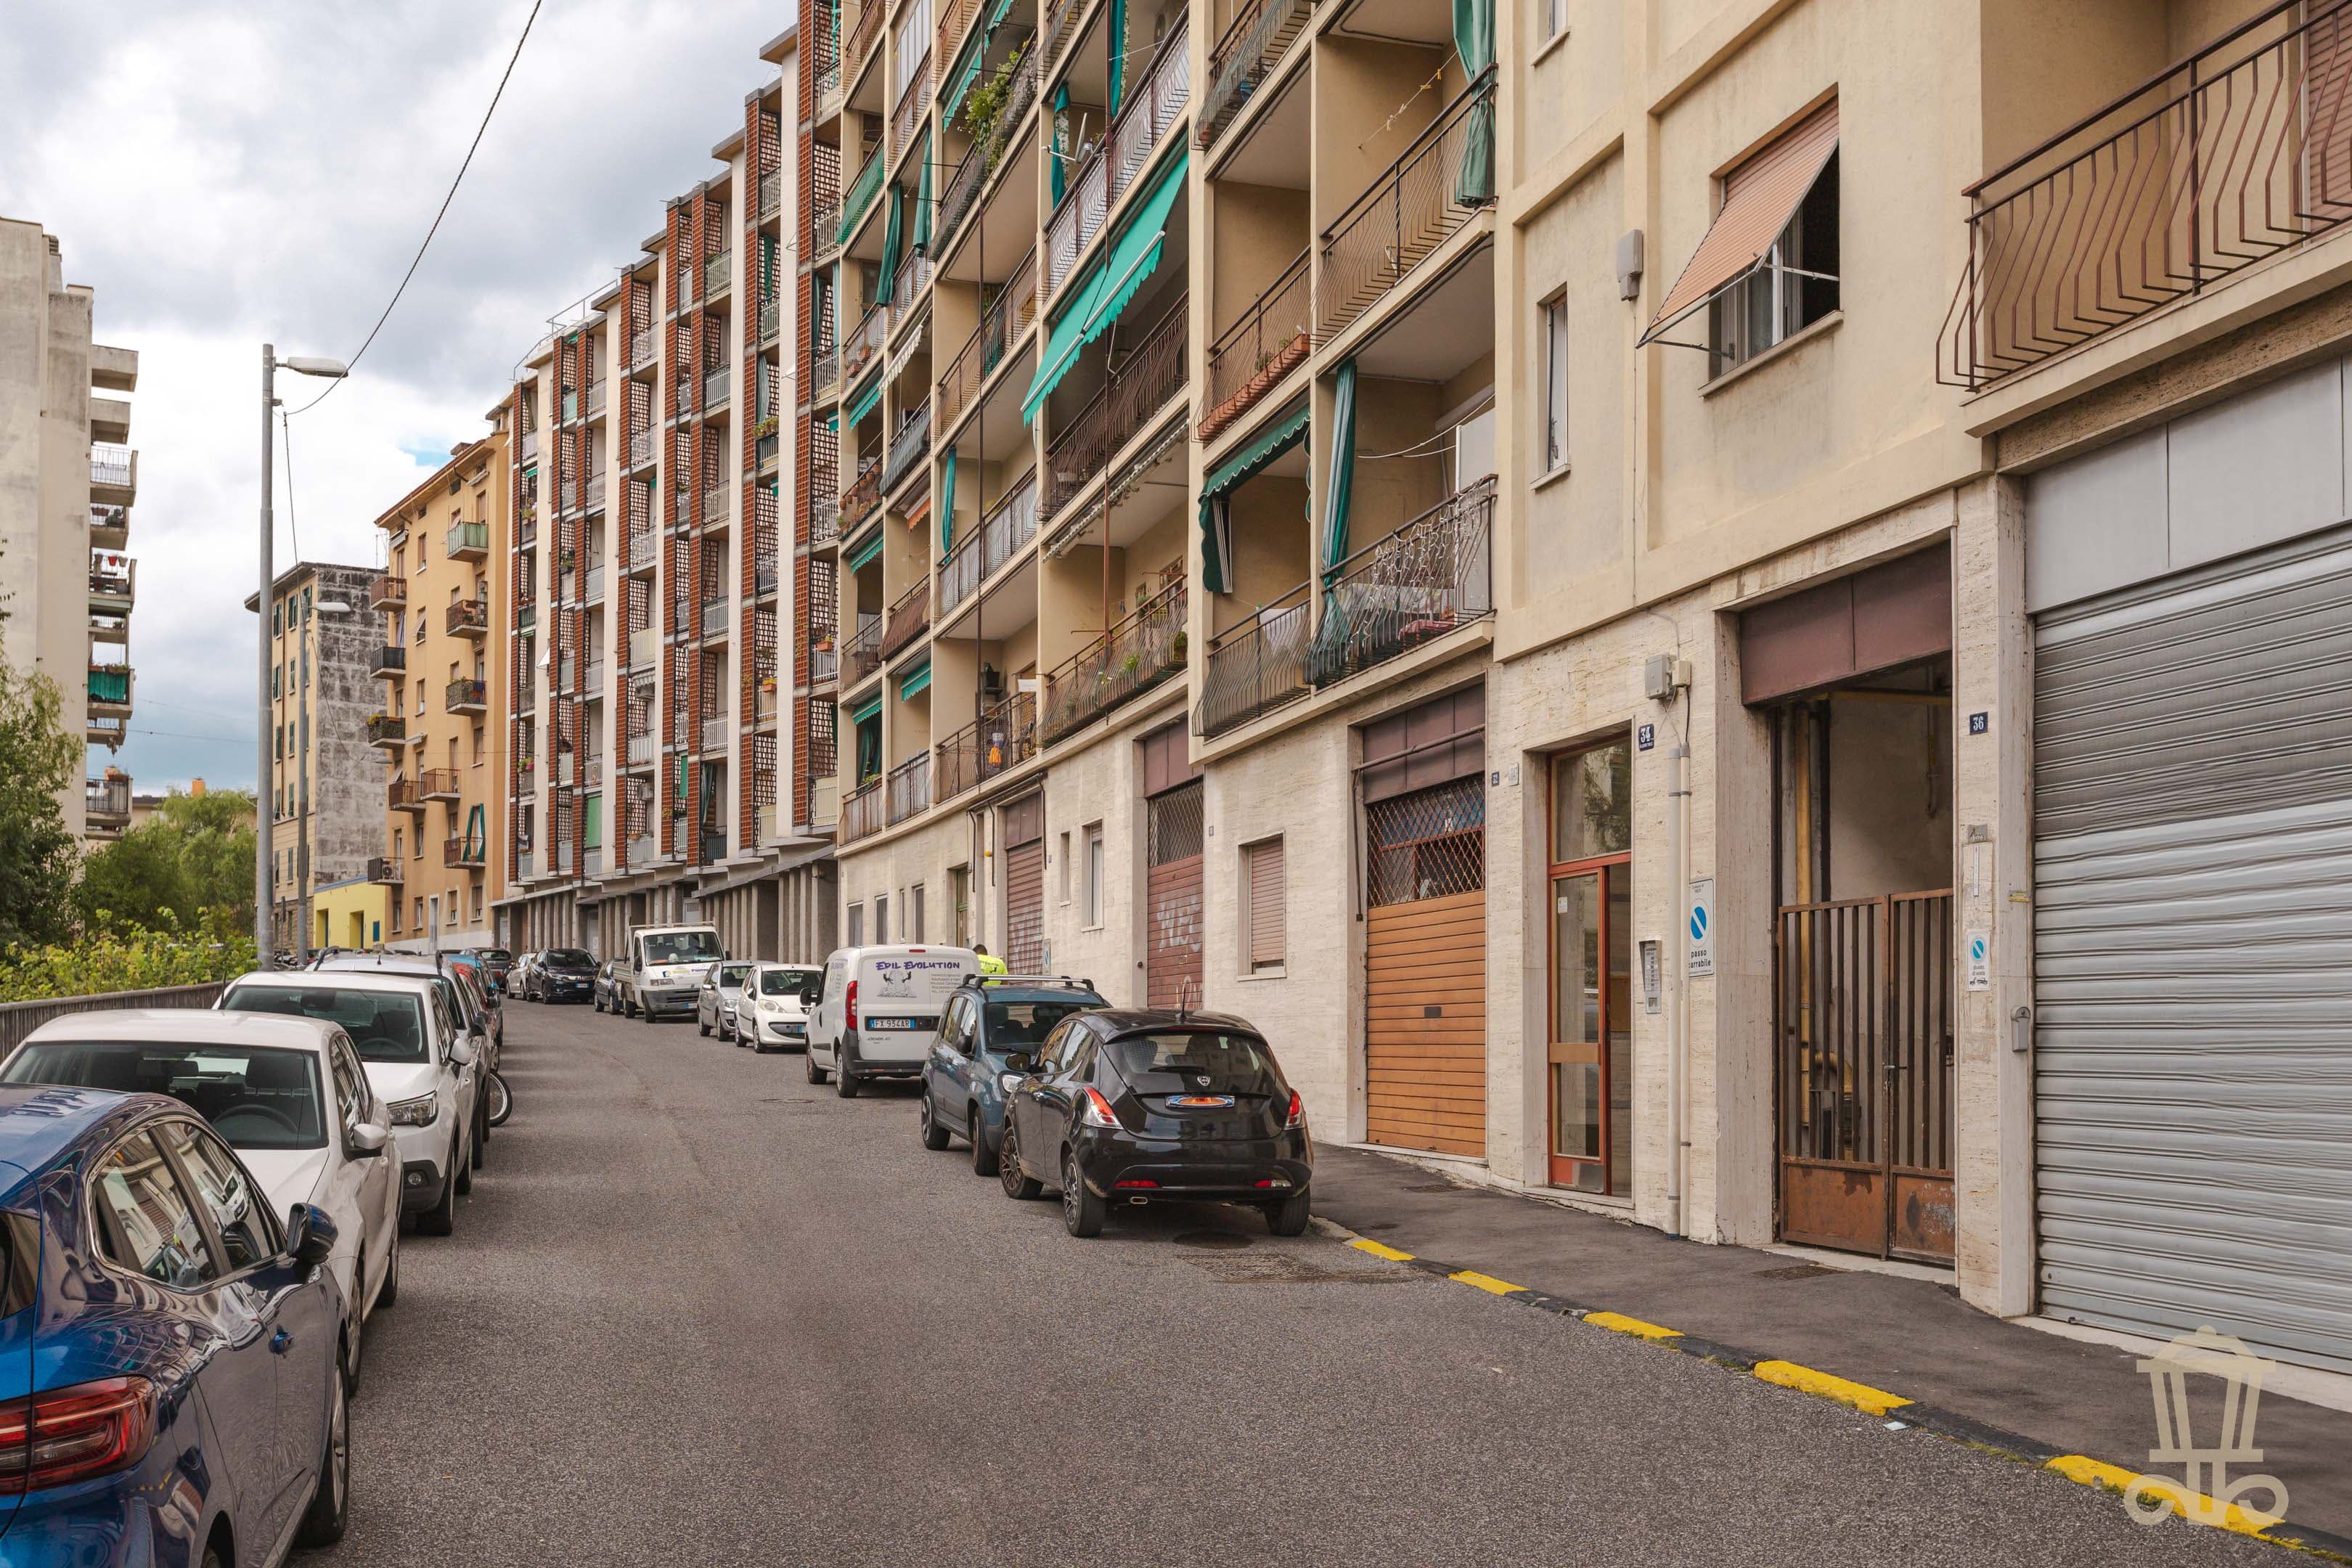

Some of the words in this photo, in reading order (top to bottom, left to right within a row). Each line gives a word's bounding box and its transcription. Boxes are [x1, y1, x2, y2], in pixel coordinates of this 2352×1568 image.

[1973, 715, 1984, 731] 36
[1641, 726, 1651, 743] 34
[1691, 950, 1707, 958] passo
[903, 960, 960, 970] EVOLUTION
